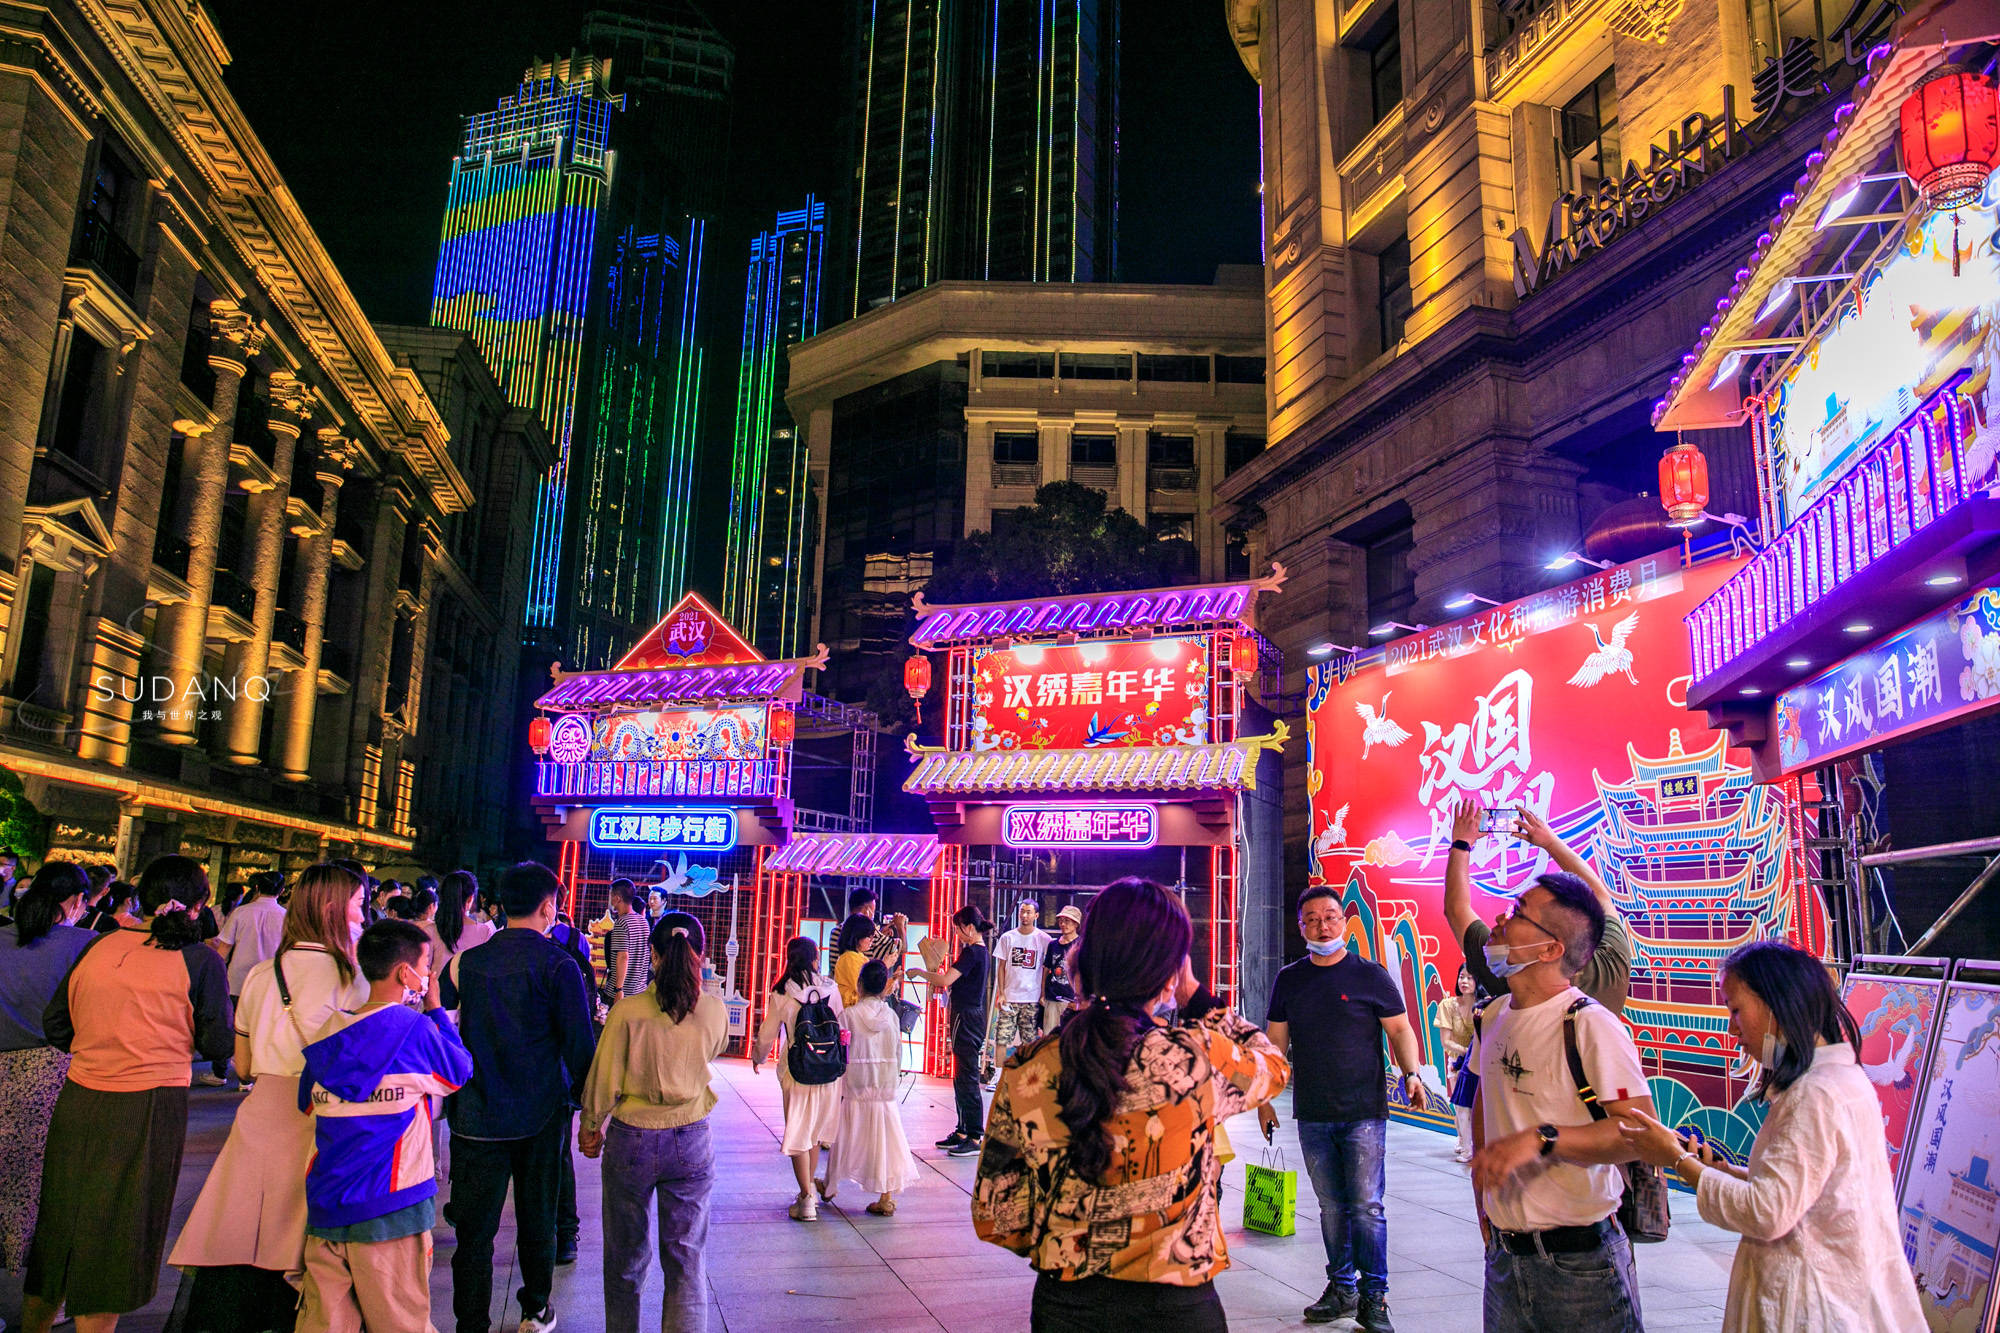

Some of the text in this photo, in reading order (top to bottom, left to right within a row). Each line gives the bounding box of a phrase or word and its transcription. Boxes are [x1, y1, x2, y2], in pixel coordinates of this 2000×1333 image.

[1571, 112, 1708, 225] GRAND
[1544, 143, 1706, 281] MADISON
[668, 620, 706, 642] 武汉
[679, 611, 699, 622] 2021
[1390, 560, 1659, 669] 2021武汉文化和旅游消费月
[1002, 668, 1176, 709] 汉绣嘉年华
[1817, 639, 1943, 747] 汉风国潮
[598, 815, 727, 843] 江汉路步行街
[1009, 810, 1149, 842] 汉绣嘉年华
[1923, 1077, 1953, 1176] 汉风国潮
